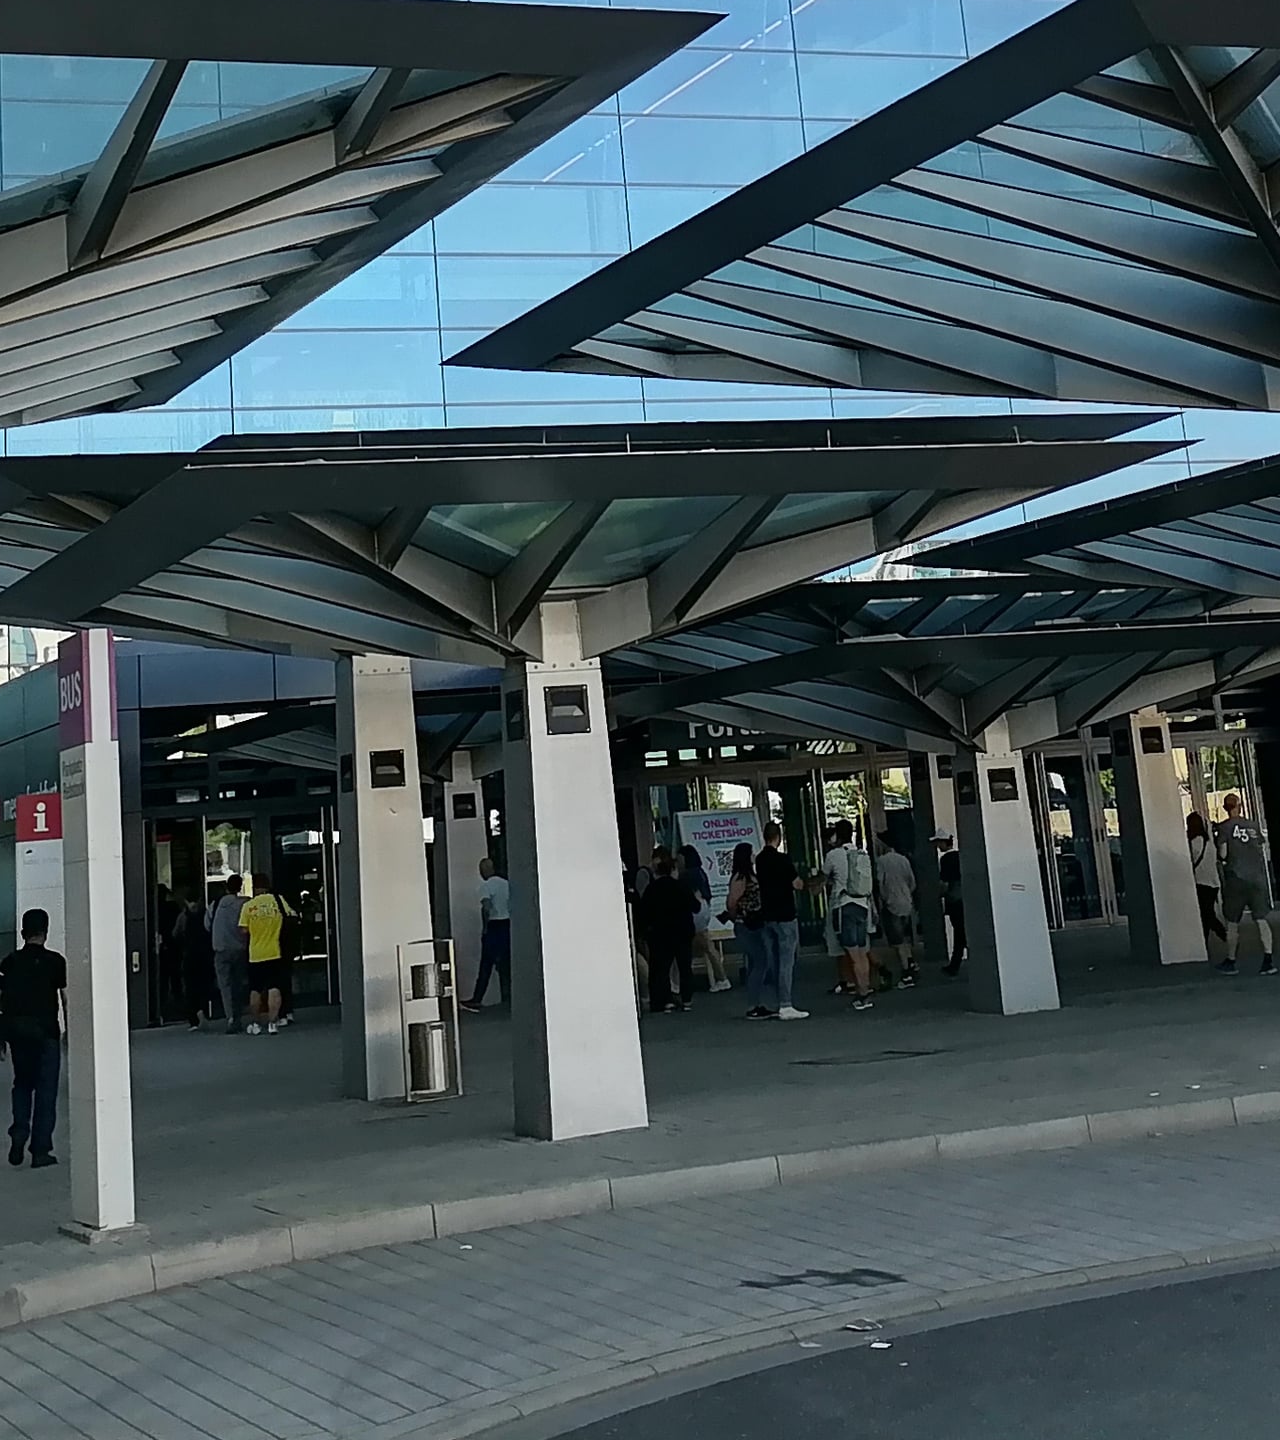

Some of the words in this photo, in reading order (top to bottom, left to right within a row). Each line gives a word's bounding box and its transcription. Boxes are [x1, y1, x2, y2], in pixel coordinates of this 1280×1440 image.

[60, 670, 82, 713] BUS
[702, 818, 740, 829] ONLINE
[692, 827, 754, 840] TICKETSHOP
[1232, 824, 1250, 843] 43
